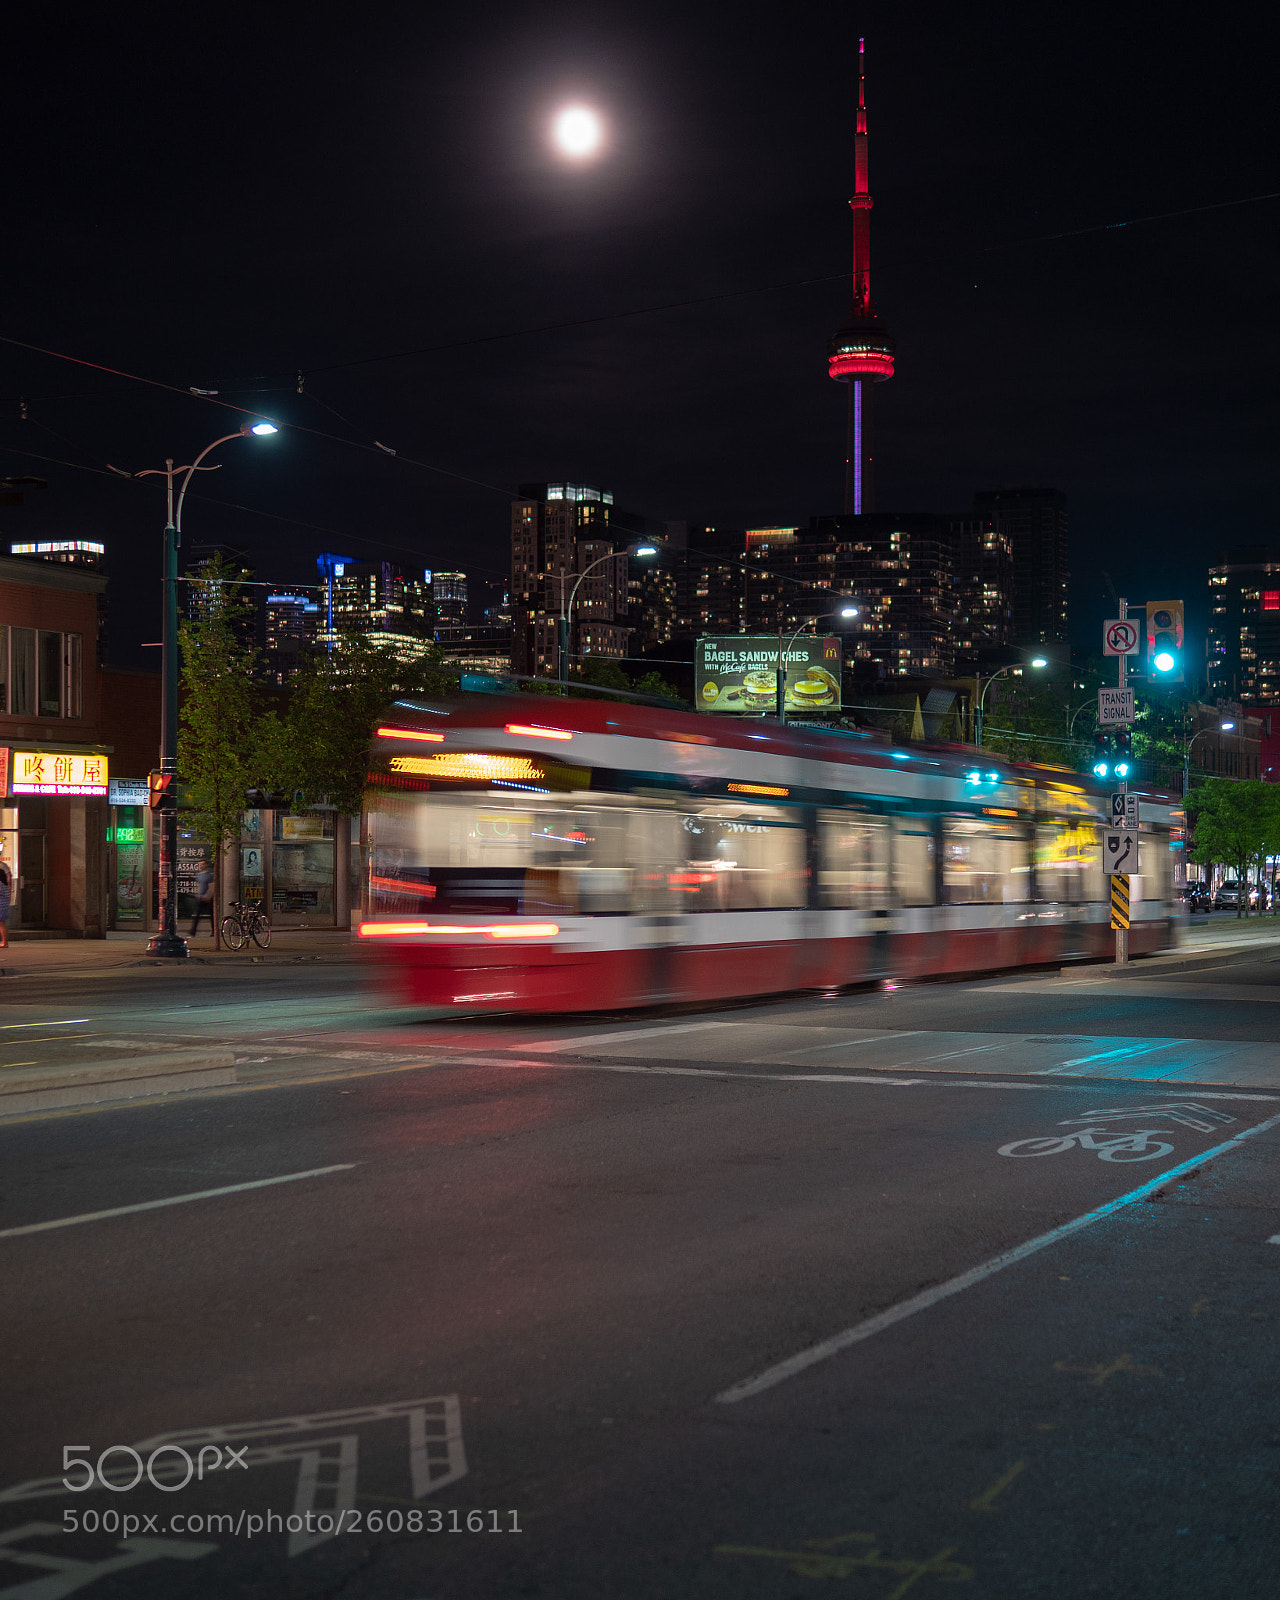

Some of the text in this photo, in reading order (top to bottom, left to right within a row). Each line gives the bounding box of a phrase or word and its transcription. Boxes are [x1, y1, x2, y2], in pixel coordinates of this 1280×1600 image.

[704, 651, 809, 662] BAGEL SANDWCHES
[1101, 692, 1131, 705] TRANSIT
[1103, 707, 1131, 719] SIGNAL
